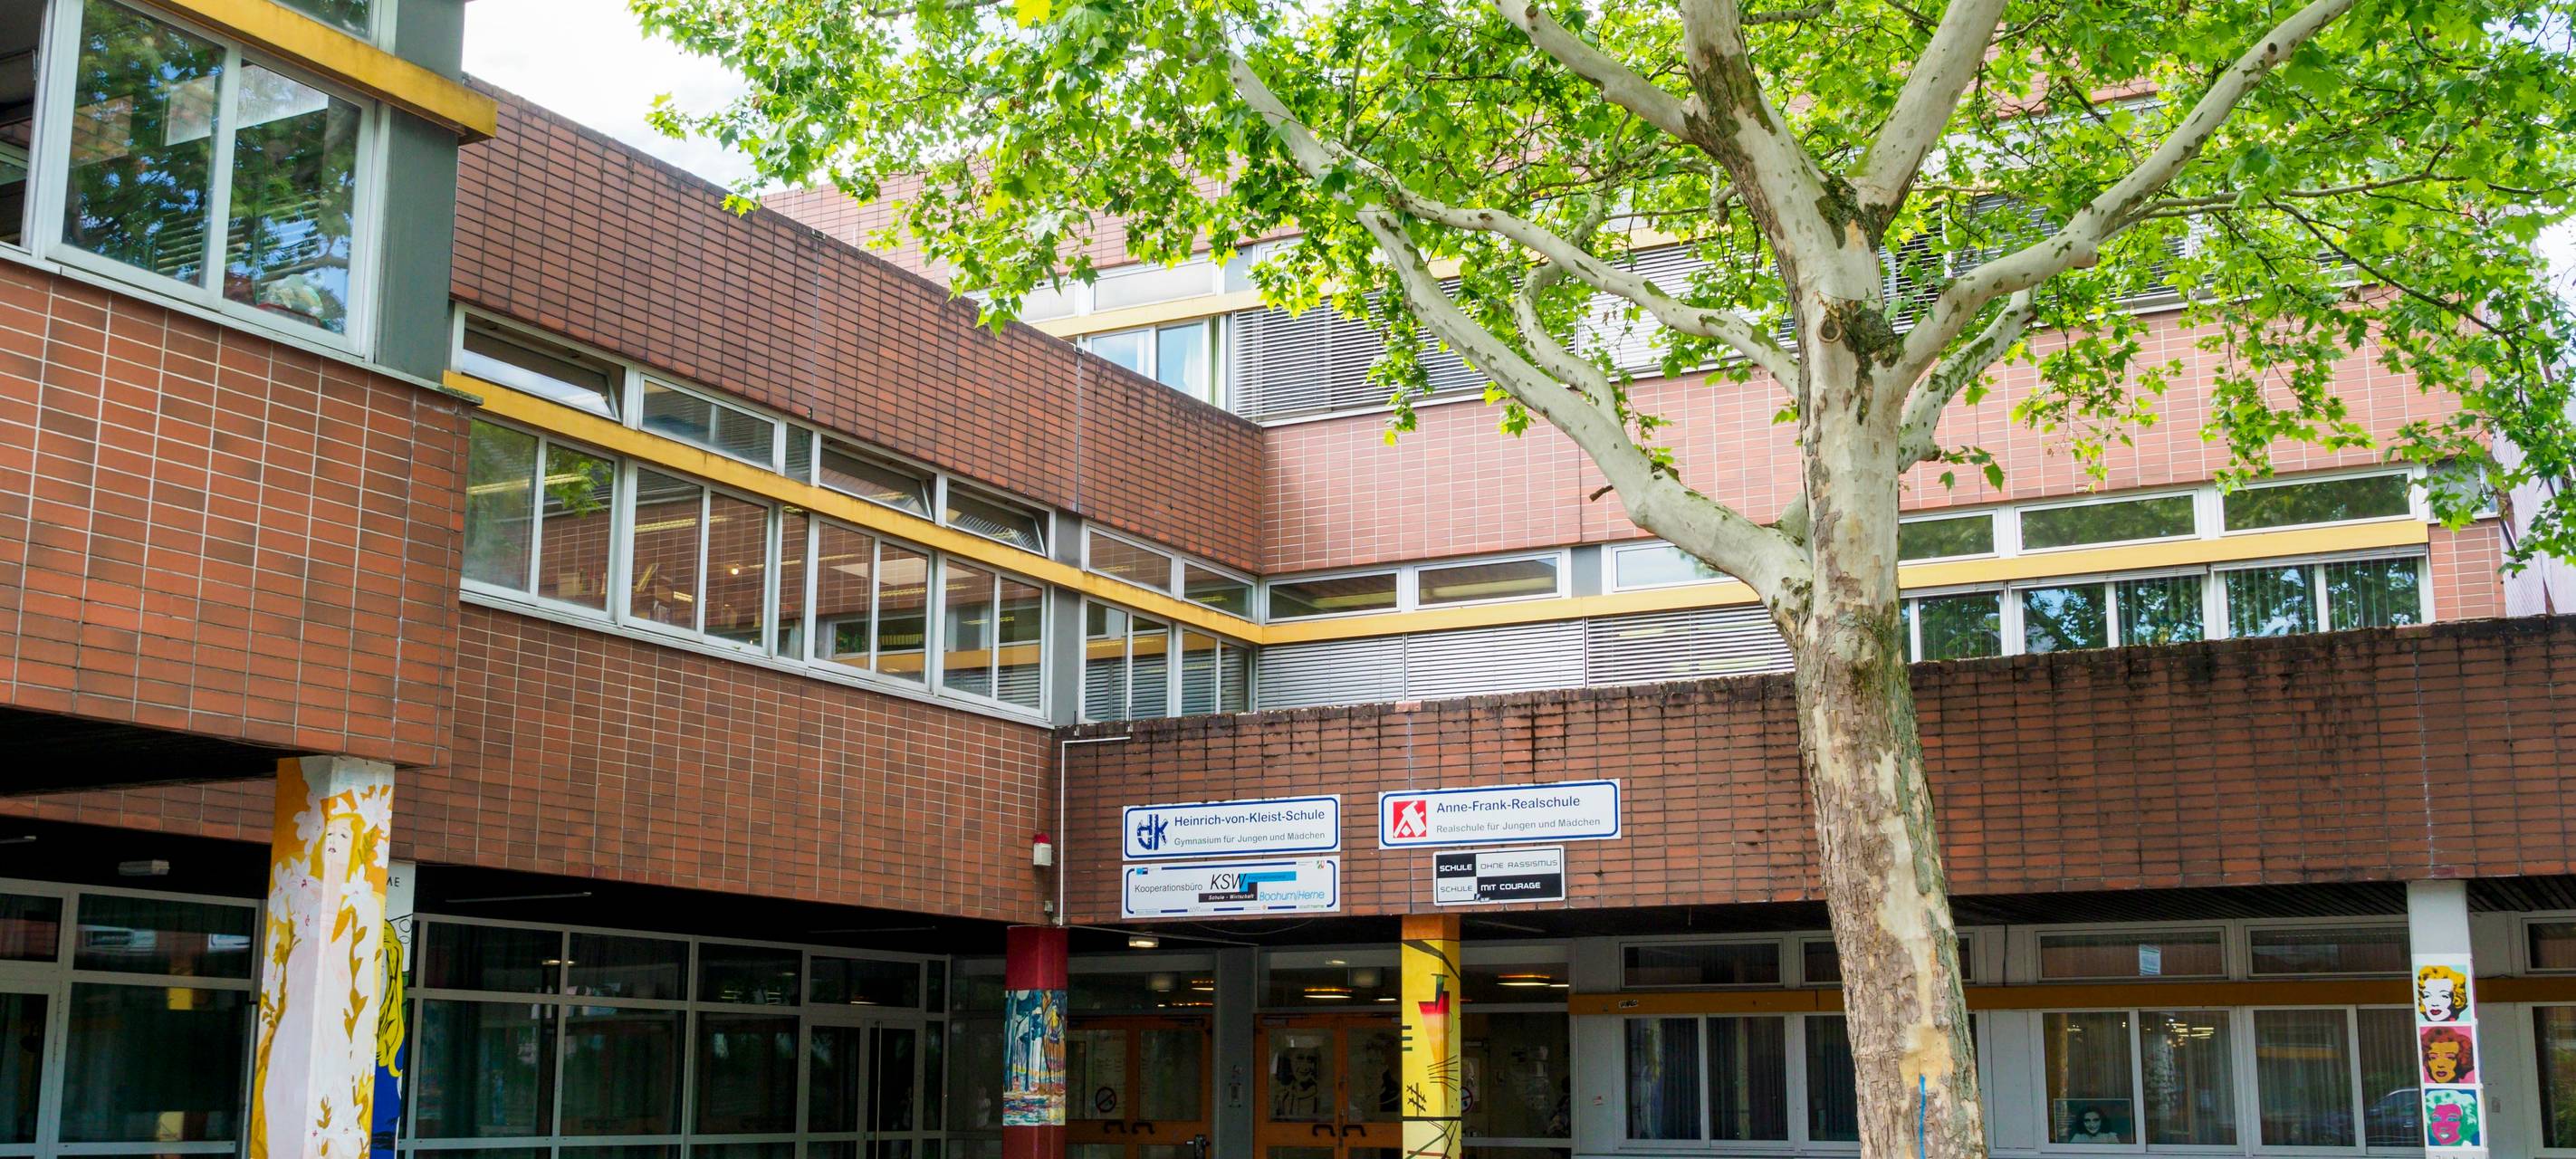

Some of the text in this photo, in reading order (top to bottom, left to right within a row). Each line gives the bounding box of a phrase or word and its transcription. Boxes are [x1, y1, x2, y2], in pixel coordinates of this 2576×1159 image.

[1436, 795, 1581, 813] Anne-Frank-Realschule
[1174, 809, 1325, 827] Heinrich-von-Kleist-Schule
[1436, 818, 1601, 833] Realschule für Jungen und Mädchen
[1173, 831, 1326, 847] Gymnasium für Jungen und Mädchen
[1439, 864, 1472, 872] SCHULE
[1508, 859, 1558, 868] RASSISMUS
[1135, 883, 1203, 894] Kooperationsbüro
[1210, 873, 1247, 890] KSW
[1440, 882, 1541, 893] SCHULE MIT COURAGE
[1259, 890, 1326, 901] Bochum/Herne
